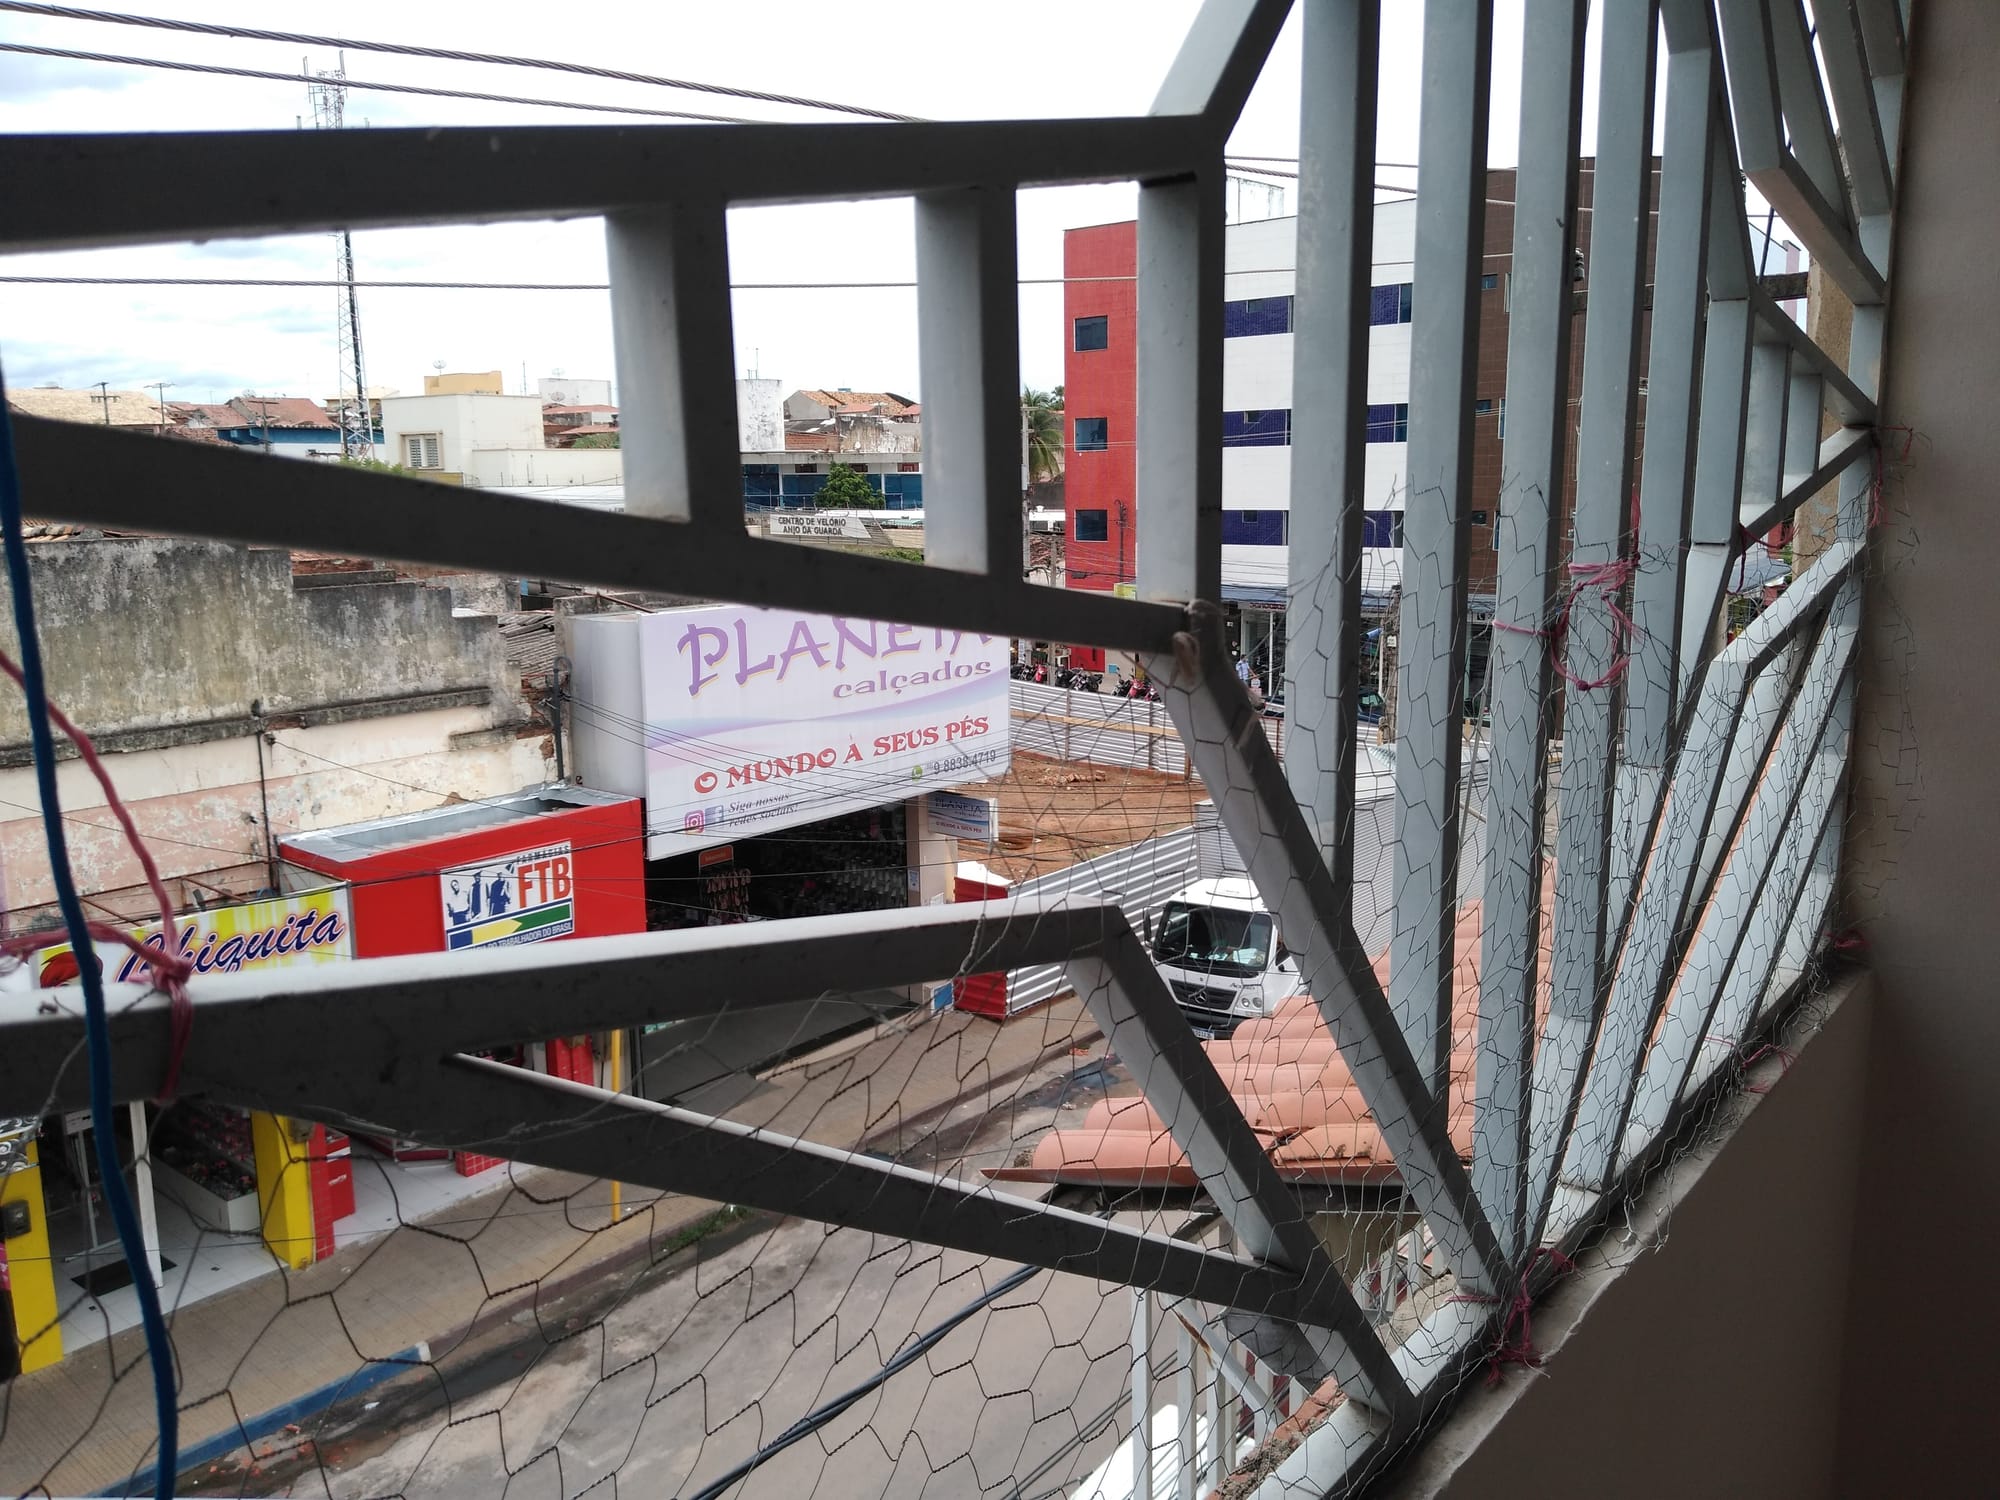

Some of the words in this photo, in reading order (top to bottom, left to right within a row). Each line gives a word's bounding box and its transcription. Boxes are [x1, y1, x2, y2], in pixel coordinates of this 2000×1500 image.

[778, 516, 804, 525] CENTRO
[805, 517, 815, 525] DE
[817, 516, 846, 527] VELÓRIO
[783, 527, 800, 535] ANJO
[814, 527, 842, 536] GUARDA
[832, 660, 992, 699] calçados
[693, 771, 718, 794] O
[725, 748, 837, 789] MUNDO
[873, 726, 939, 756] SEUS
[944, 715, 990, 742] PÉS
[728, 800, 752, 814] Siga
[517, 857, 571, 909] FTB
[542, 927, 552, 938] DO
[552, 921, 573, 935] BRASIL
